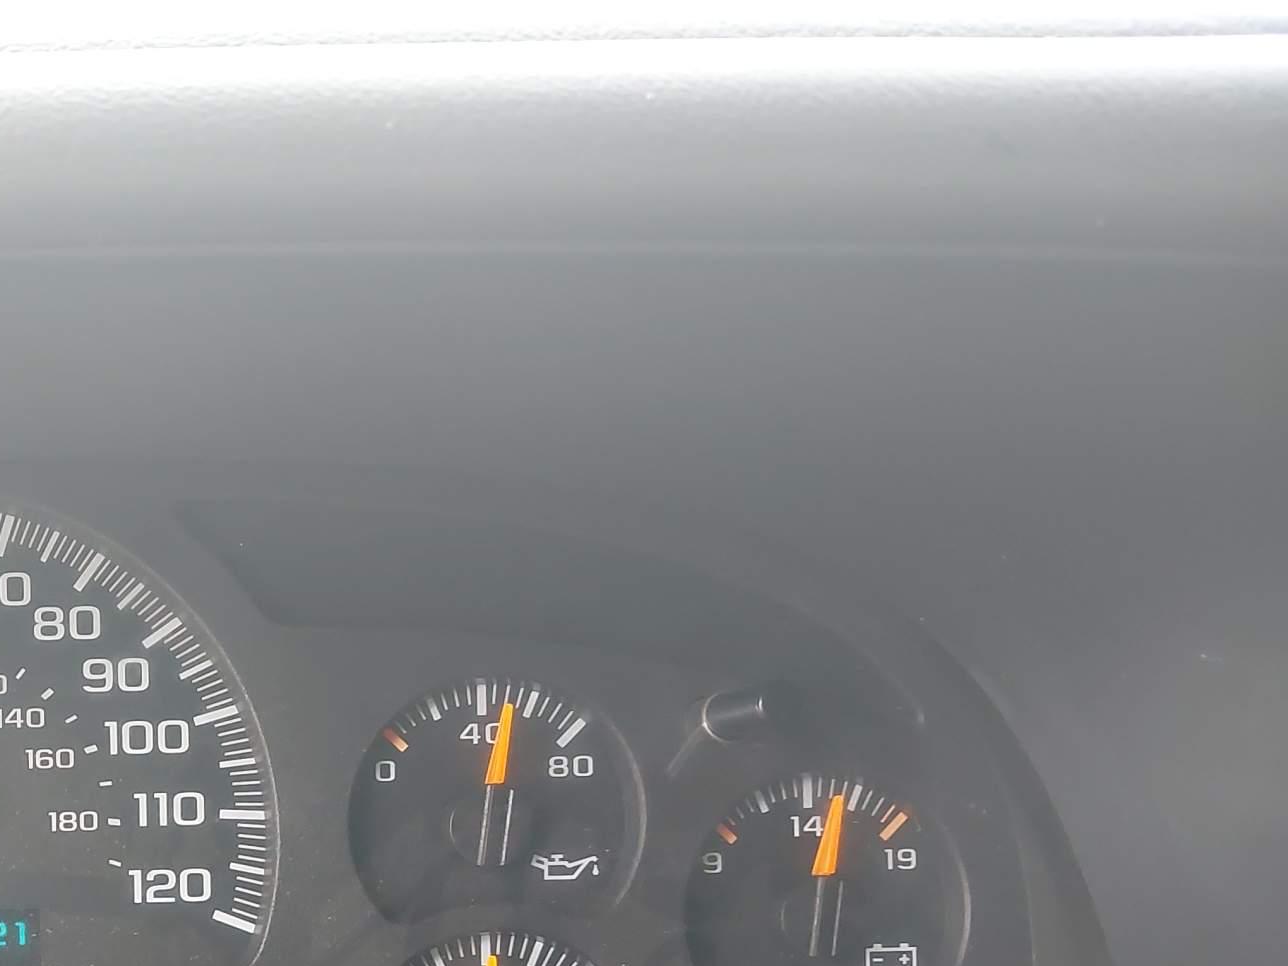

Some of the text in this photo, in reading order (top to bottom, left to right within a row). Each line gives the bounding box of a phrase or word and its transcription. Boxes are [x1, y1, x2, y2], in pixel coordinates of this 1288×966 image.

[34, 606, 101, 641] 80
[83, 658, 150, 693] 90
[105, 720, 190, 755] 100
[459, 723, 502, 744] 40
[26, 749, 75, 770] 160
[549, 756, 594, 777] 80
[375, 761, 396, 782] 0
[134, 792, 205, 827] 110
[48, 811, 98, 832] 180
[791, 816, 824, 837] 14
[703, 853, 723, 874] 9
[884, 848, 917, 870] 19
[128, 869, 212, 904] 120
